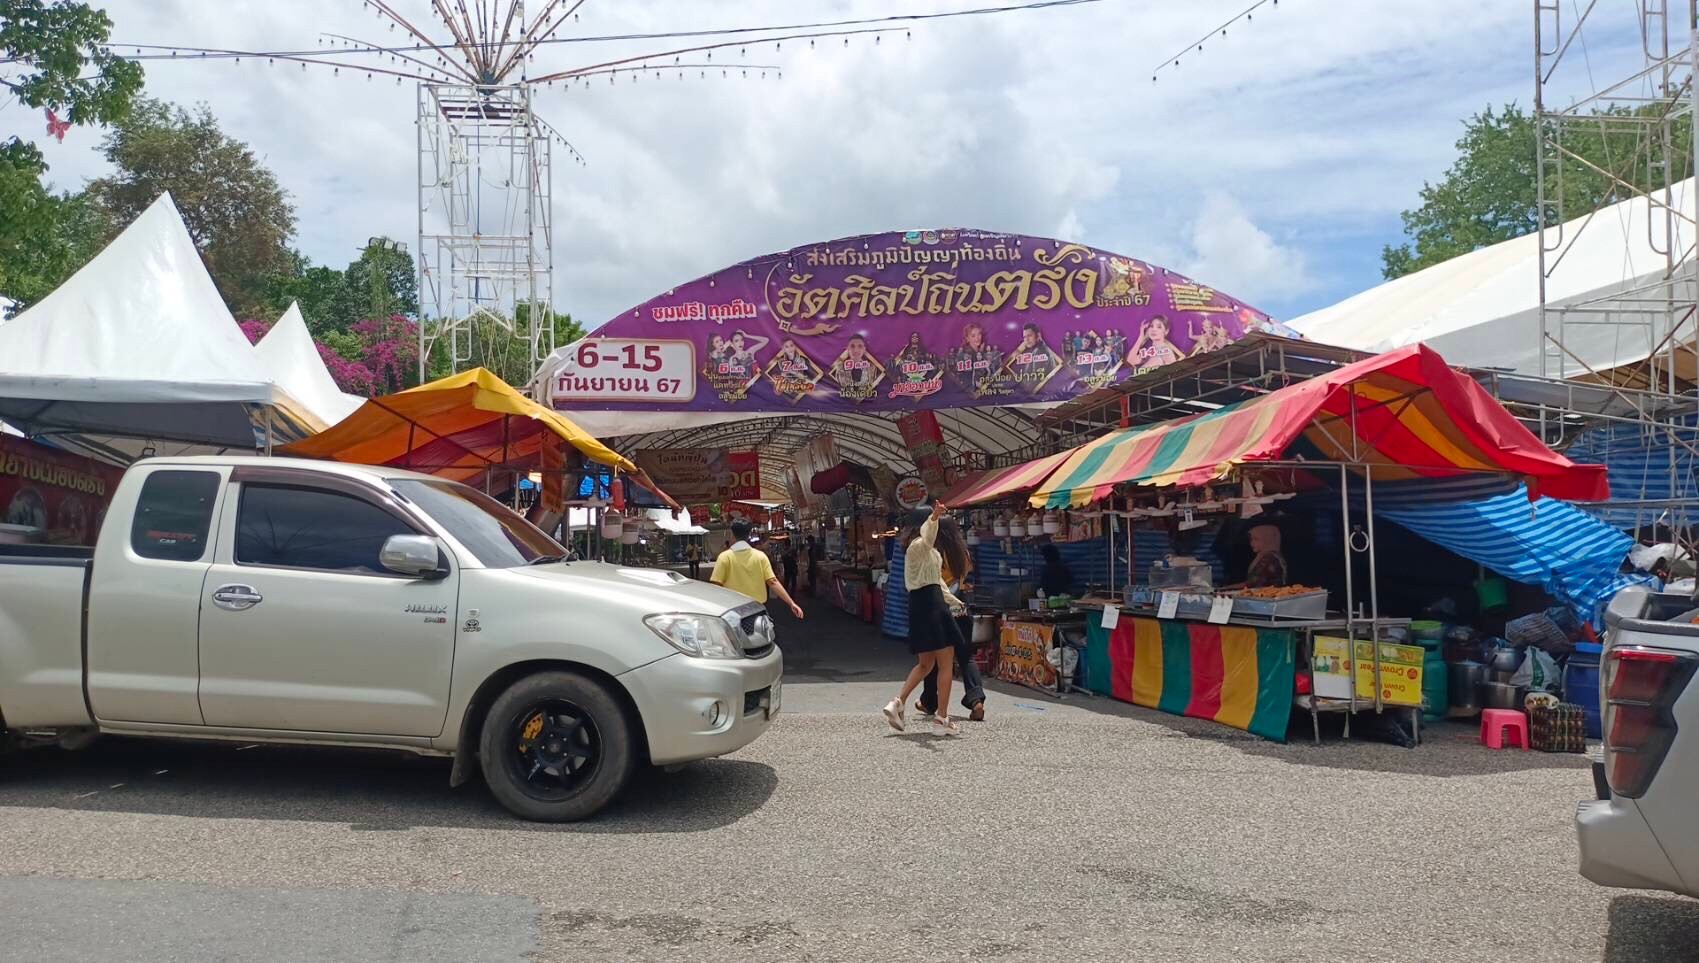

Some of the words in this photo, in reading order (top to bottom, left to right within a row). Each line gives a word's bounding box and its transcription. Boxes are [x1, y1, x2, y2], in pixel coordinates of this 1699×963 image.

[653, 302, 704, 321] ชมฟรี!
[708, 299, 756, 323] ทุกคืน
[1140, 346, 1156, 358] 14
[1016, 353, 1032, 364] 12
[1077, 353, 1093, 365] 13
[903, 362, 918, 373] 10
[957, 360, 972, 371] 11
[558, 371, 650, 392] กันยายน
[656, 378, 681, 394] 67
